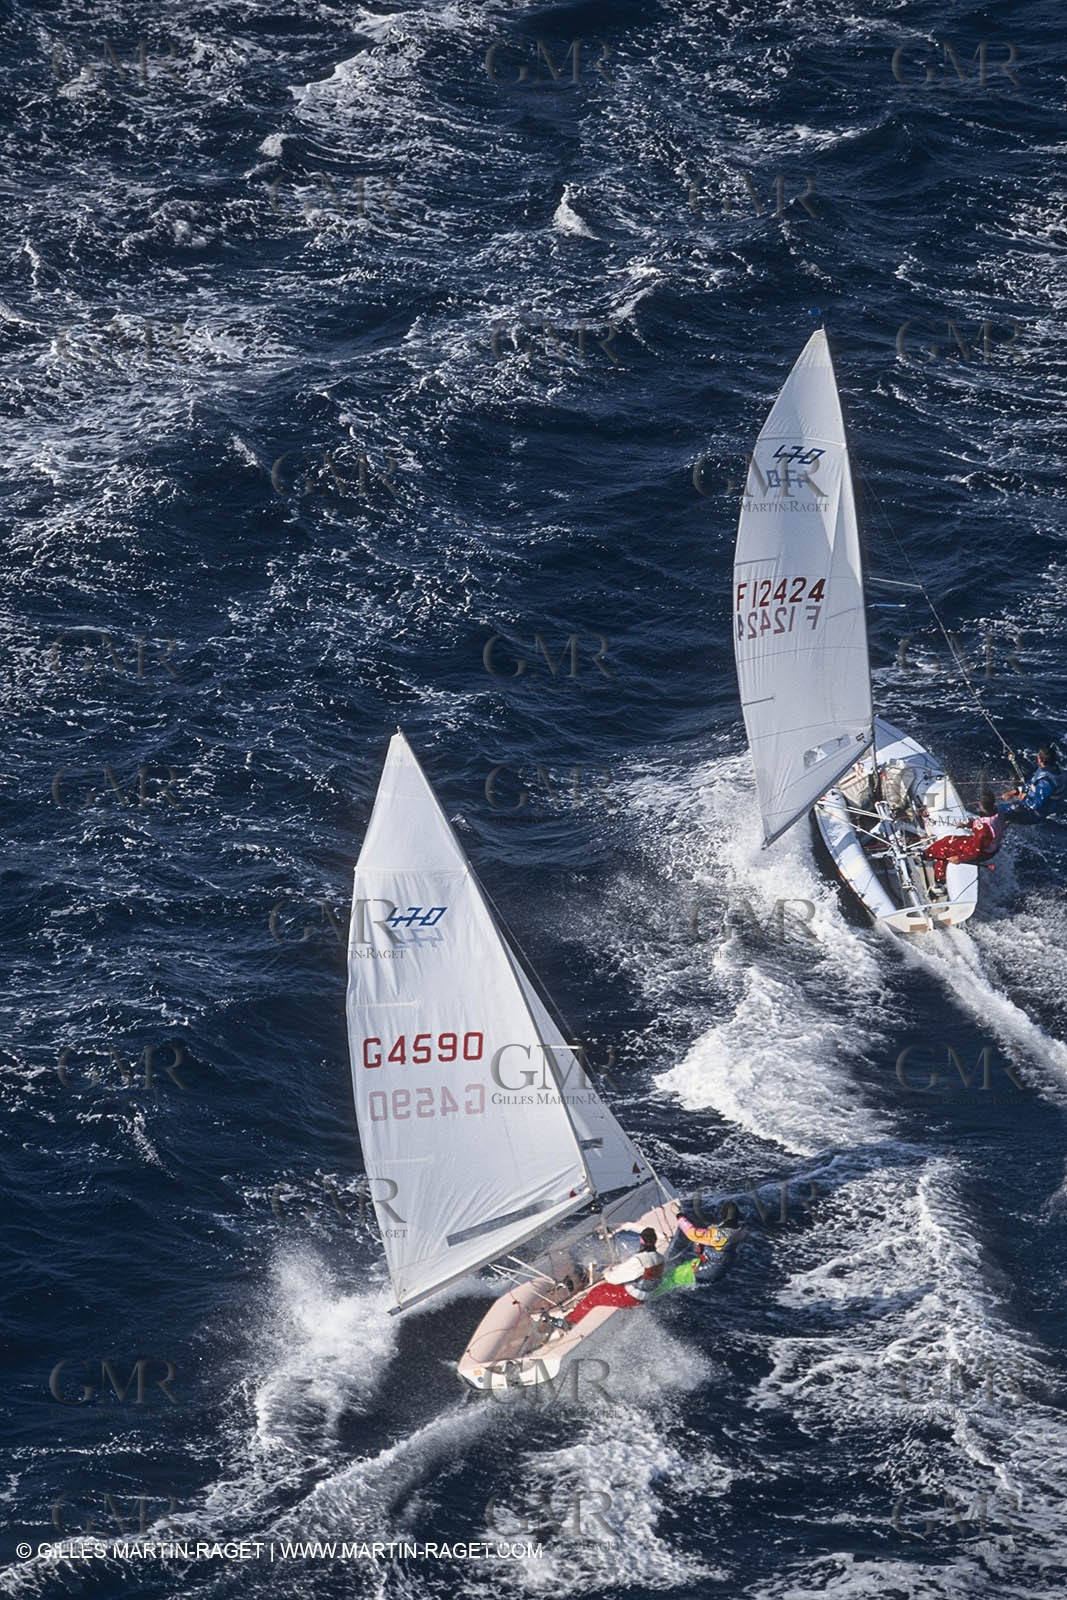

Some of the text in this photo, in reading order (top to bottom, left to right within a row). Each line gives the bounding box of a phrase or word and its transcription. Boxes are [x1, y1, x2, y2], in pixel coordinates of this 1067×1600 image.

[772, 444, 826, 464] 470
[385, 907, 447, 928] 470
[363, 1032, 483, 1068] G4590
